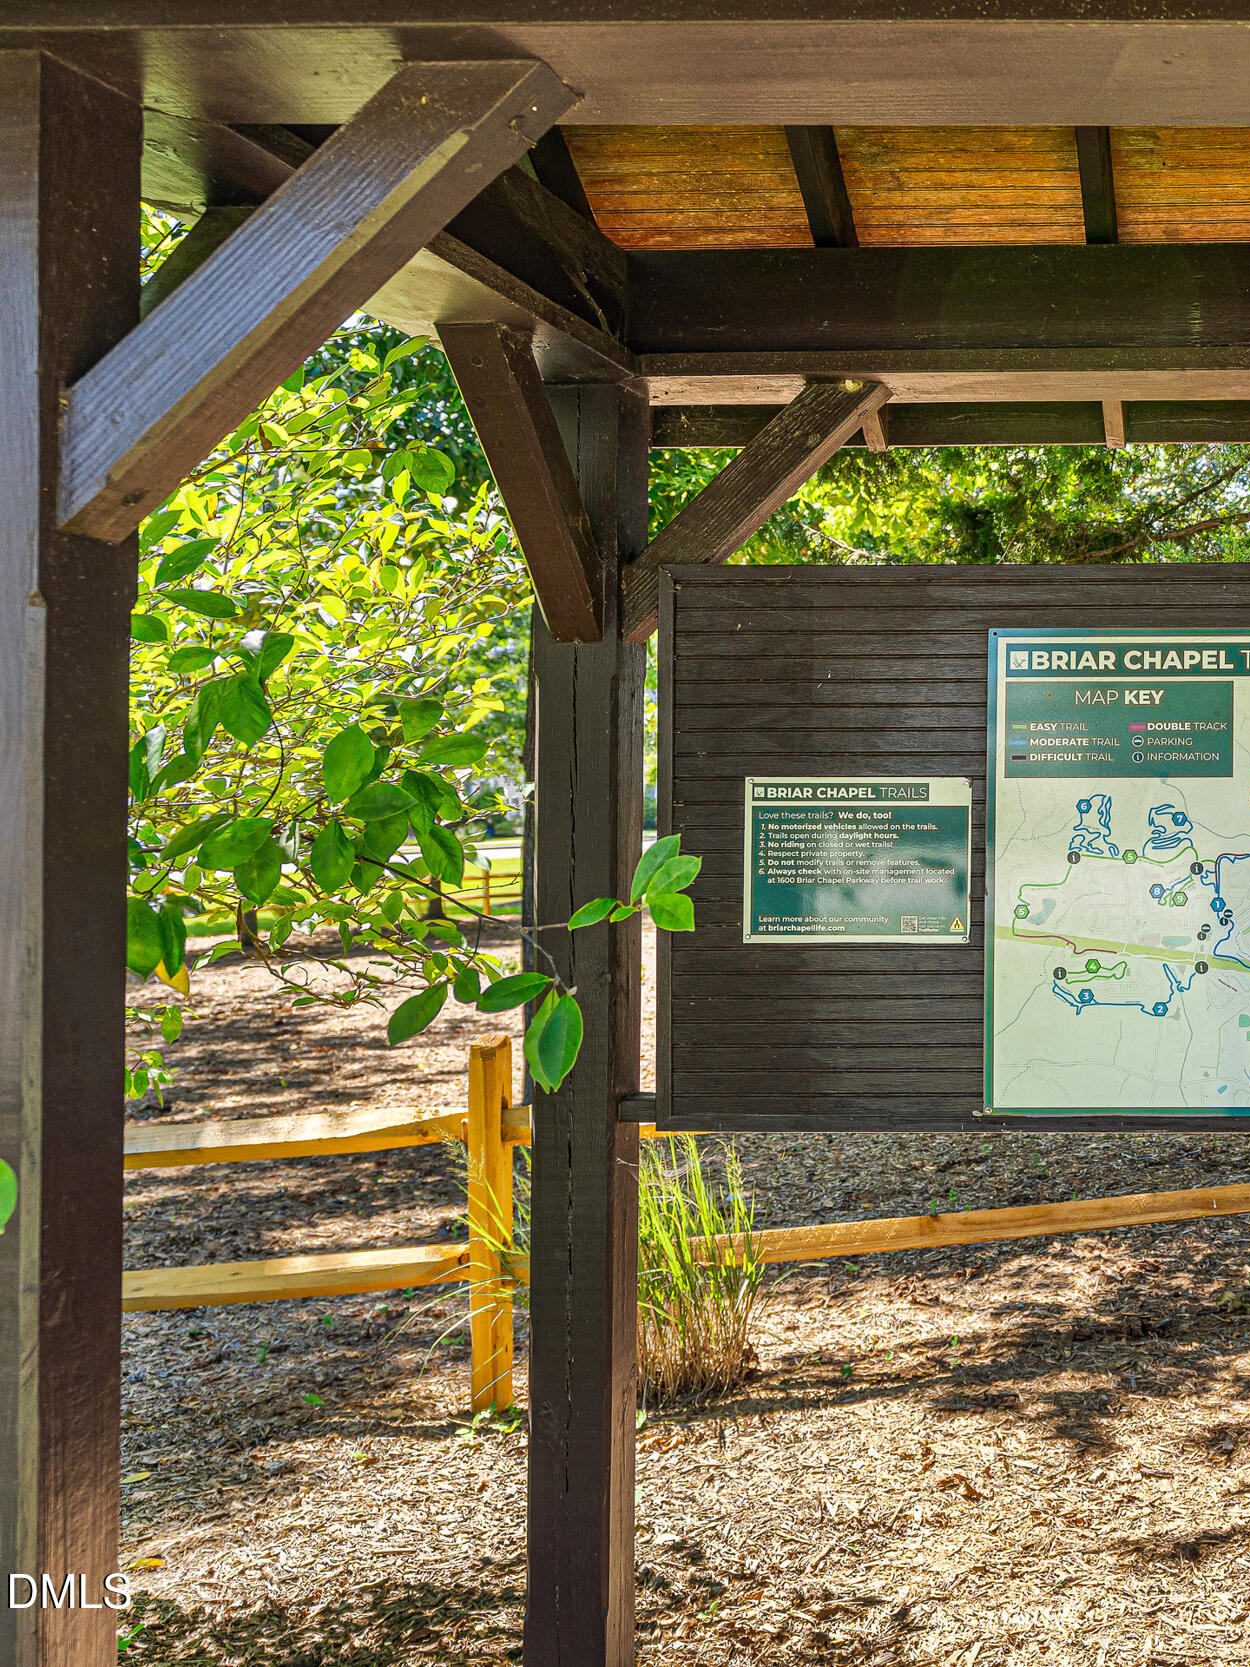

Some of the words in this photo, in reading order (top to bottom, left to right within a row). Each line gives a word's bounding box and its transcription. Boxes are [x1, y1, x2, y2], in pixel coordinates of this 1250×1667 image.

[1032, 651, 1115, 669] BRIAR
[1124, 650, 1234, 669] CHAPEL
[1075, 690, 1119, 704] MAP
[1124, 690, 1165, 704] KEY
[1030, 722, 1057, 731] EASY
[1059, 722, 1087, 731] TRAIL
[1147, 722, 1191, 731] DOUBLE
[1193, 722, 1227, 731] TRACK
[1030, 737, 1089, 746] MODERATE
[1091, 737, 1120, 746] TRAIL
[1147, 737, 1192, 746] PARKING
[1030, 753, 1083, 761] DIFFICULT
[1085, 753, 1114, 761] TRAIL
[1147, 752, 1220, 761] INFORMATION
[767, 787, 813, 799] BRIAR
[817, 787, 876, 799] CHAPEL
[880, 787, 927, 799] TRAILS
[759, 812, 779, 820] Love
[781, 812, 806, 820] these
[808, 812, 833, 820] trails?
[838, 812, 854, 820] We
[856, 812, 871, 821] do,
[873, 812, 892, 820] too!
[768, 868, 796, 876] Always
[817, 877, 844, 885] Chapel
[846, 877, 878, 885] Parkway
[844, 916, 888, 924] community
